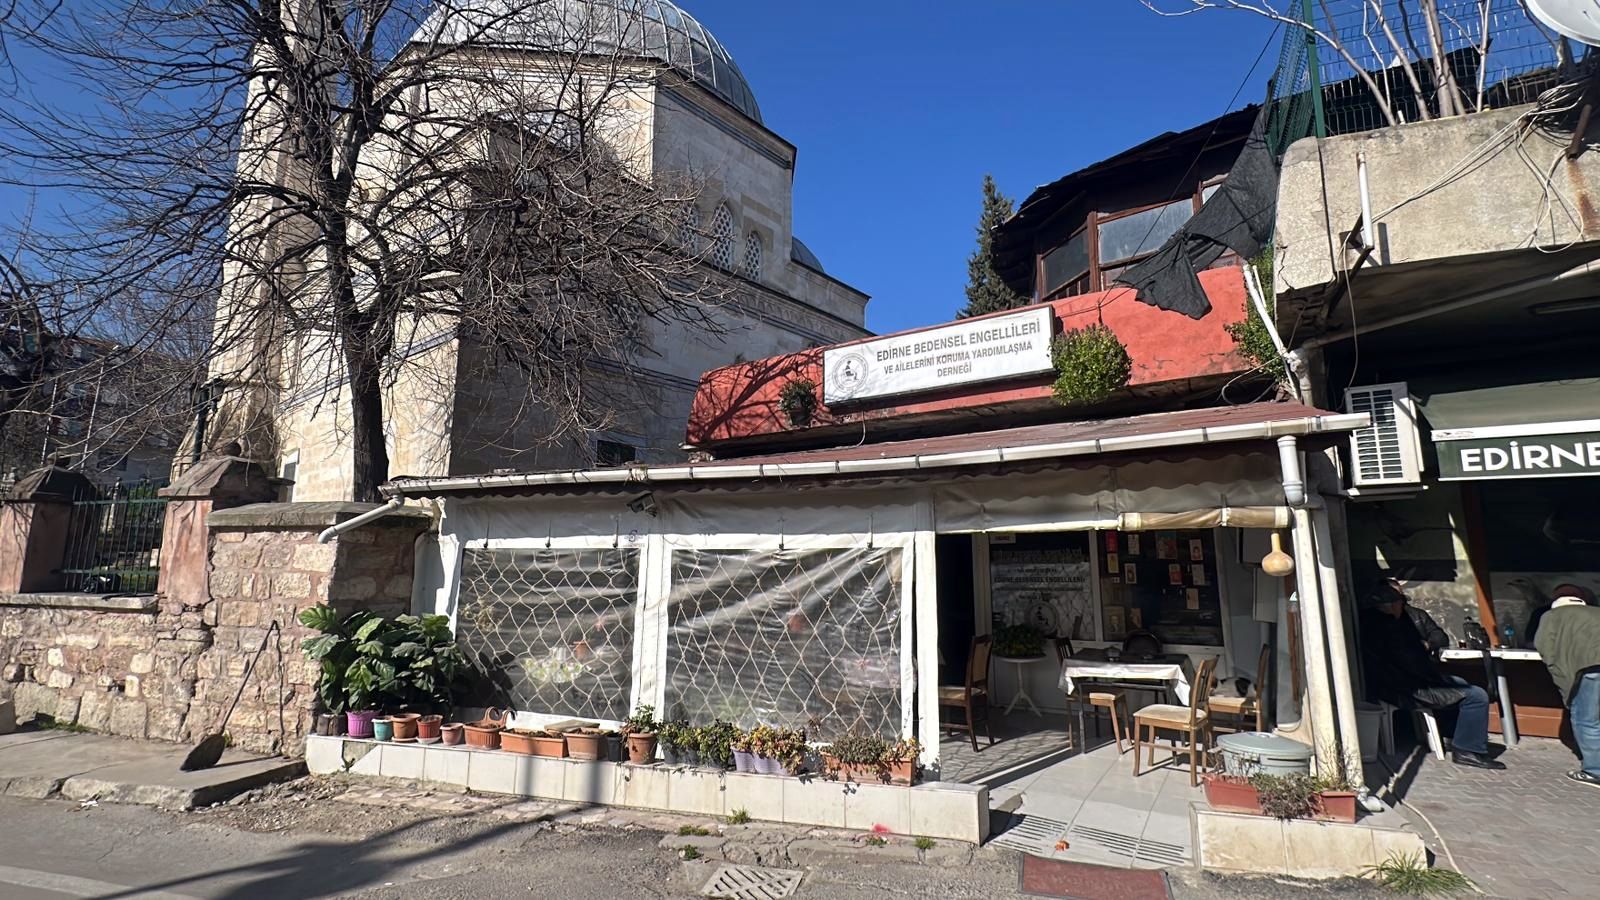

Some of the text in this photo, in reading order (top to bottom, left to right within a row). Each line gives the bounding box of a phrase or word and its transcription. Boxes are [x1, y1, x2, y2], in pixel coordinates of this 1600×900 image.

[877, 318, 1040, 362] EDİRNE BEDENSEL ENGELLİLERİ
[884, 341, 1033, 374] VE AİLELERİNİ KORUMA YARDIMLAŞMA
[937, 361, 972, 377] DERNEĞİ
